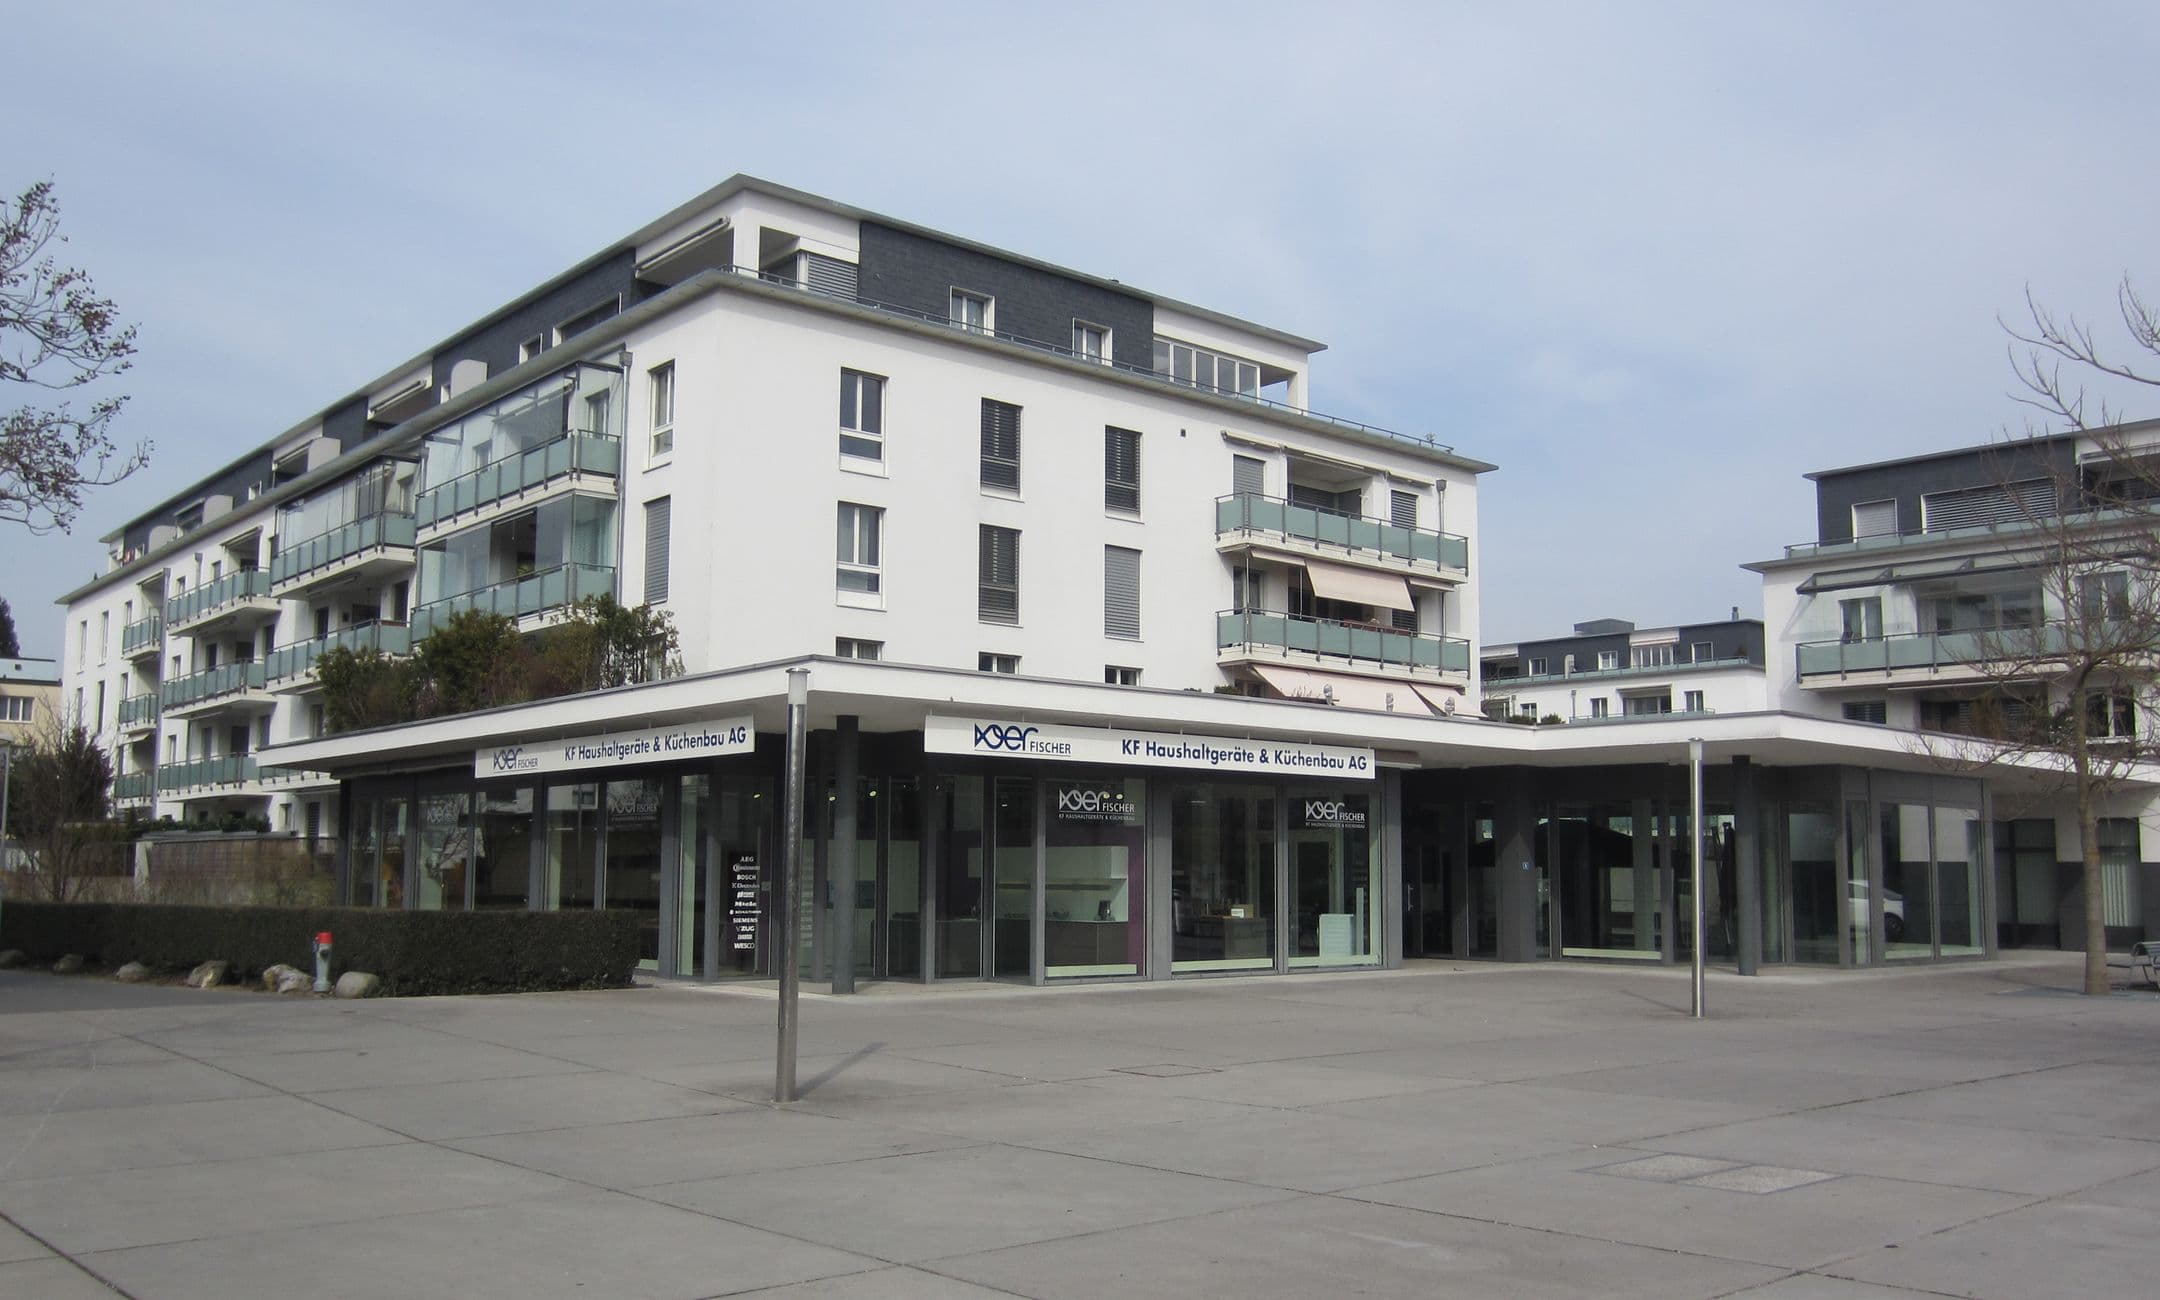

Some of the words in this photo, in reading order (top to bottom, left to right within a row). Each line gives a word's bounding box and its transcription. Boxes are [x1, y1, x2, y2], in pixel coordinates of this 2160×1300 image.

[564, 746, 576, 761] KF
[579, 738, 650, 761] Haushaltgeräte
[653, 739, 660, 752] &
[664, 731, 725, 751] Küchenbau
[729, 726, 747, 744] AG
[1030, 741, 1071, 754] FISCHER
[1122, 739, 1140, 755] KF
[1146, 741, 1255, 765] Haushaltgeräte
[1259, 748, 1269, 763] &
[1274, 750, 1344, 769] Küchenbau
[1348, 756, 1367, 770] AG
[518, 758, 539, 769] FISCHER
[1102, 802, 1135, 813] FISCHER
[1340, 812, 1365, 821] FISCHER
